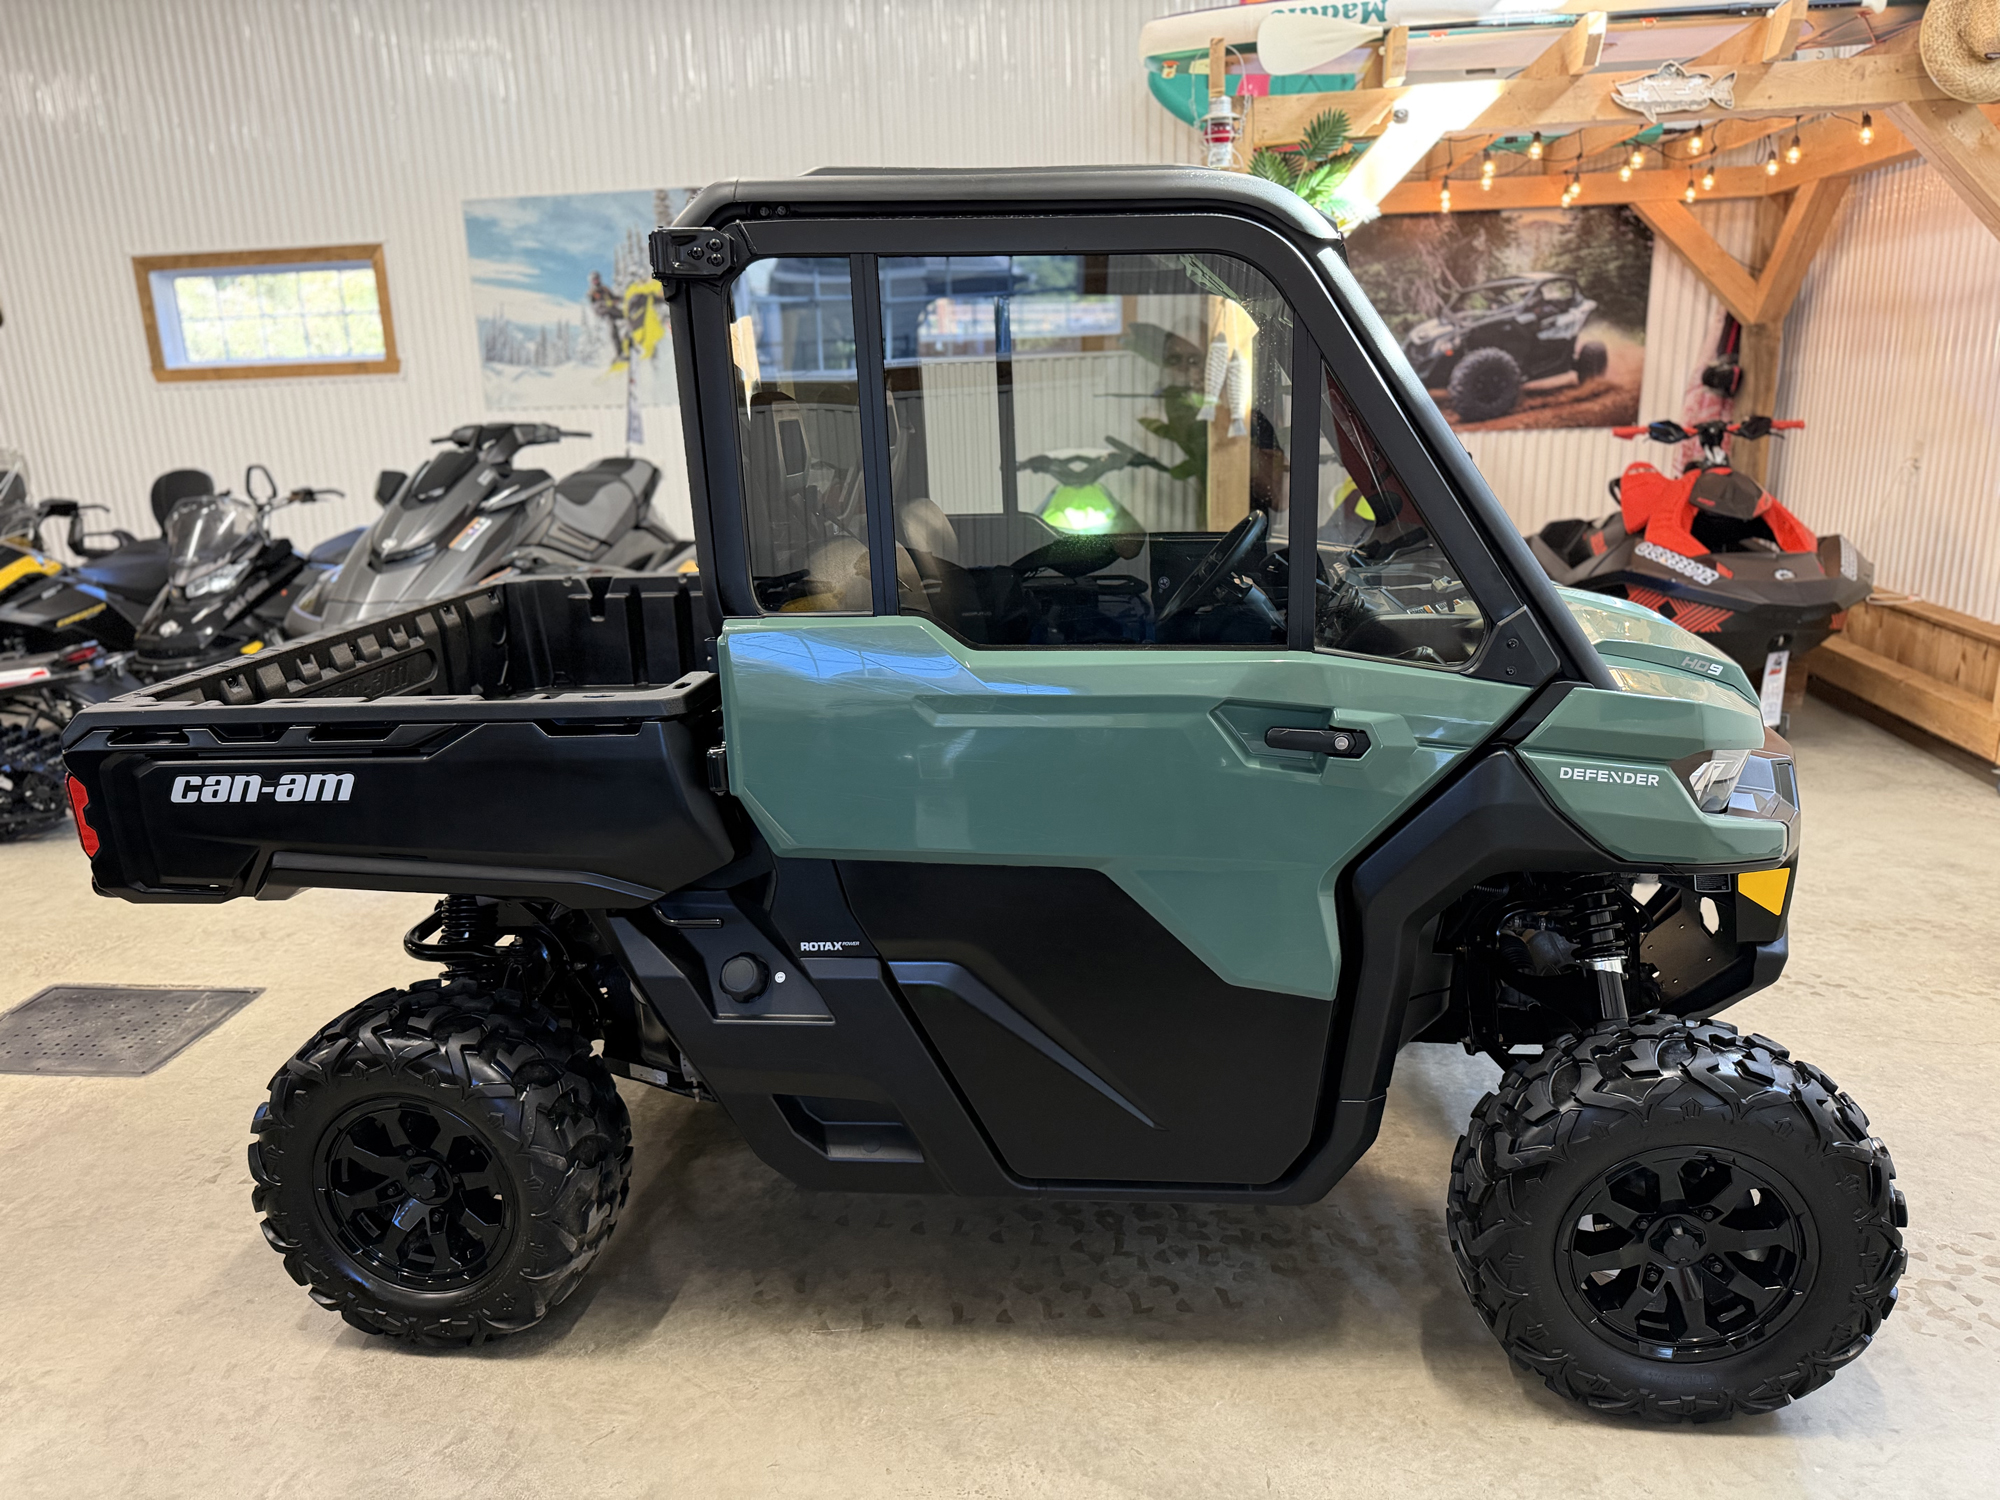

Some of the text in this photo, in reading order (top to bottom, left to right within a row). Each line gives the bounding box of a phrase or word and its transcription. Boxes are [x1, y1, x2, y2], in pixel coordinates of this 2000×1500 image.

[1680, 656, 1724, 676] HD9
[1559, 766, 1660, 787] DEFENDER
[170, 773, 355, 804] can-am
[800, 941, 843, 952] ROTAX
